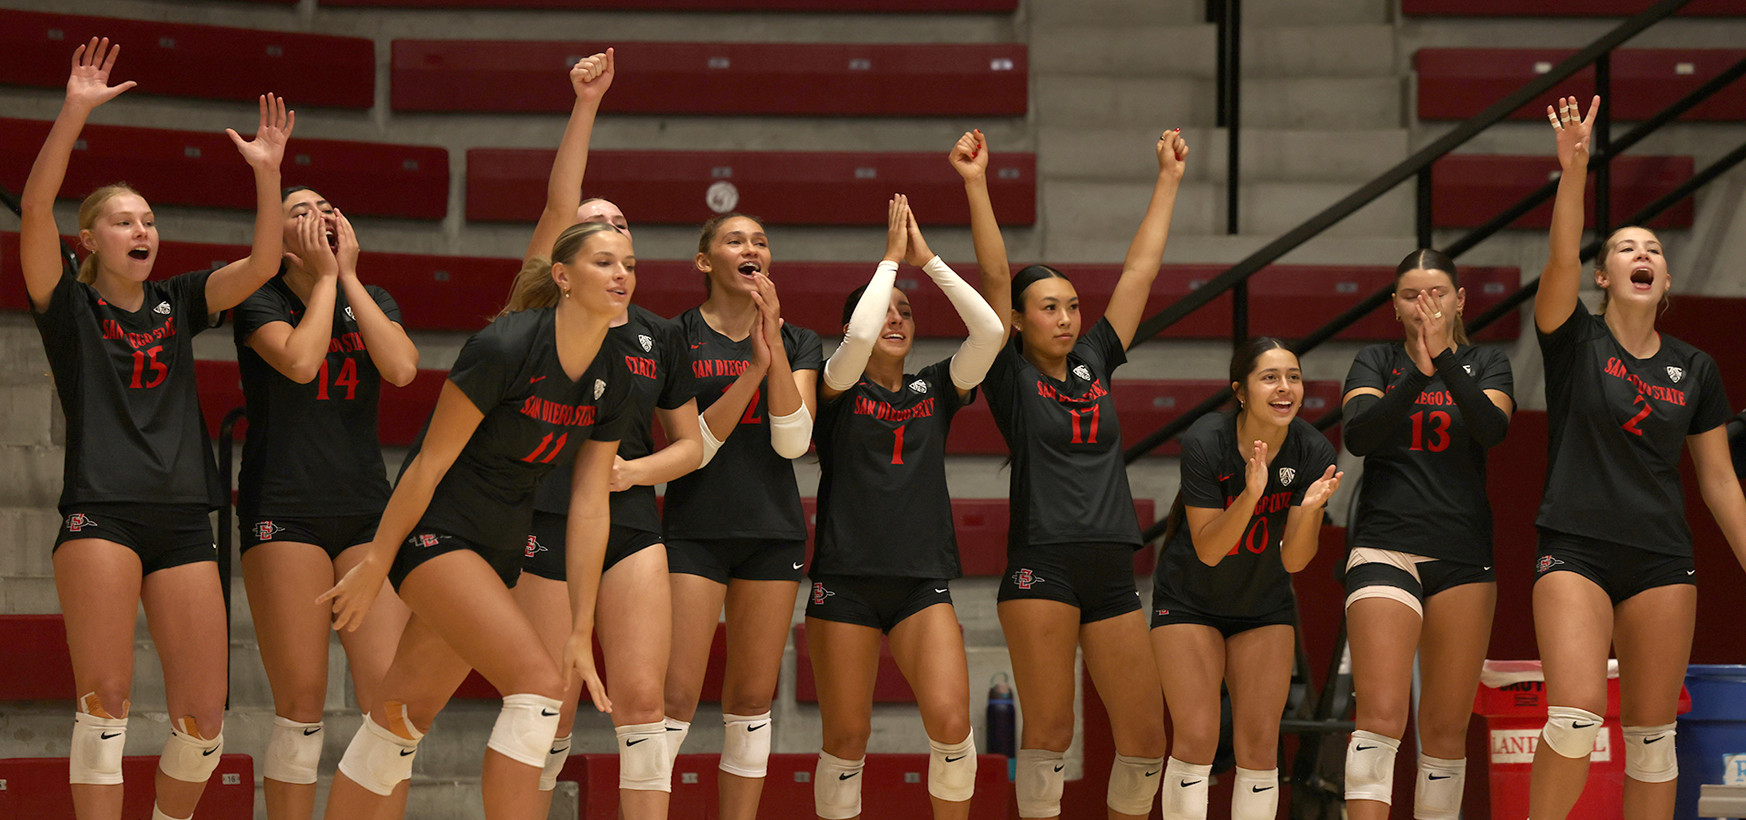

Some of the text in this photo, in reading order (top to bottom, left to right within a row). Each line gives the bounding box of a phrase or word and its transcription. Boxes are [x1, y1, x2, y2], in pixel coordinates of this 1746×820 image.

[341, 331, 367, 353] STA
[129, 345, 168, 388] 15
[316, 357, 360, 400] 14
[691, 359, 714, 379] SAN
[1604, 356, 1628, 379] SAN
[1651, 385, 1687, 406] STATE
[520, 395, 543, 420] SAN
[542, 400, 574, 426] DIEGO
[854, 395, 877, 415] SAN
[1414, 391, 1444, 406] IEGO
[1621, 394, 1653, 437] 2
[1070, 403, 1099, 444] 17
[1409, 410, 1452, 452] 13
[520, 431, 568, 463] 11
[890, 424, 905, 465] 1
